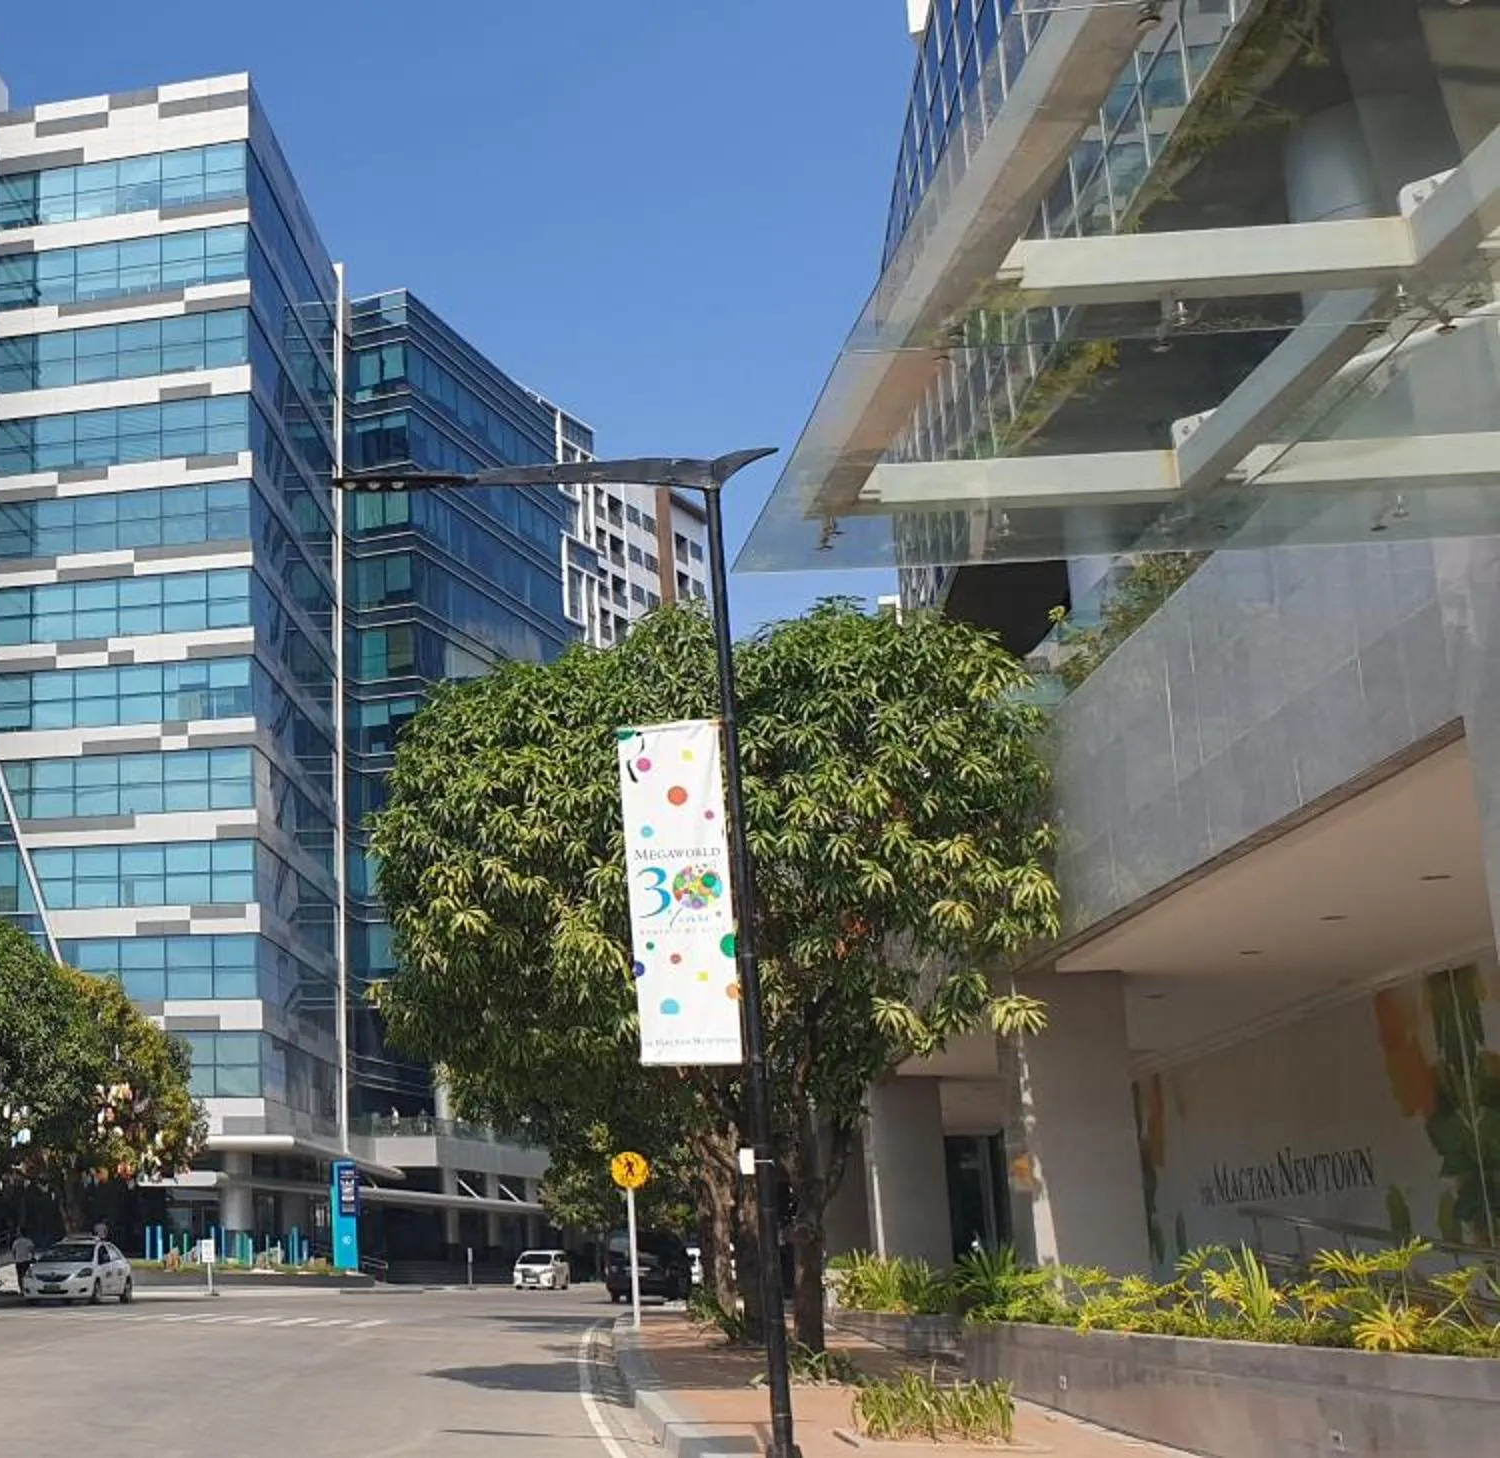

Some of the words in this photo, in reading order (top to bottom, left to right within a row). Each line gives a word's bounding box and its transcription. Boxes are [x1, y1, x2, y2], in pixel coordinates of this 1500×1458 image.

[634, 848, 721, 861] MEGAWORLD
[1213, 1161, 1276, 1202] MACTAN
[1277, 1146, 1376, 1197] NEWTOWN
